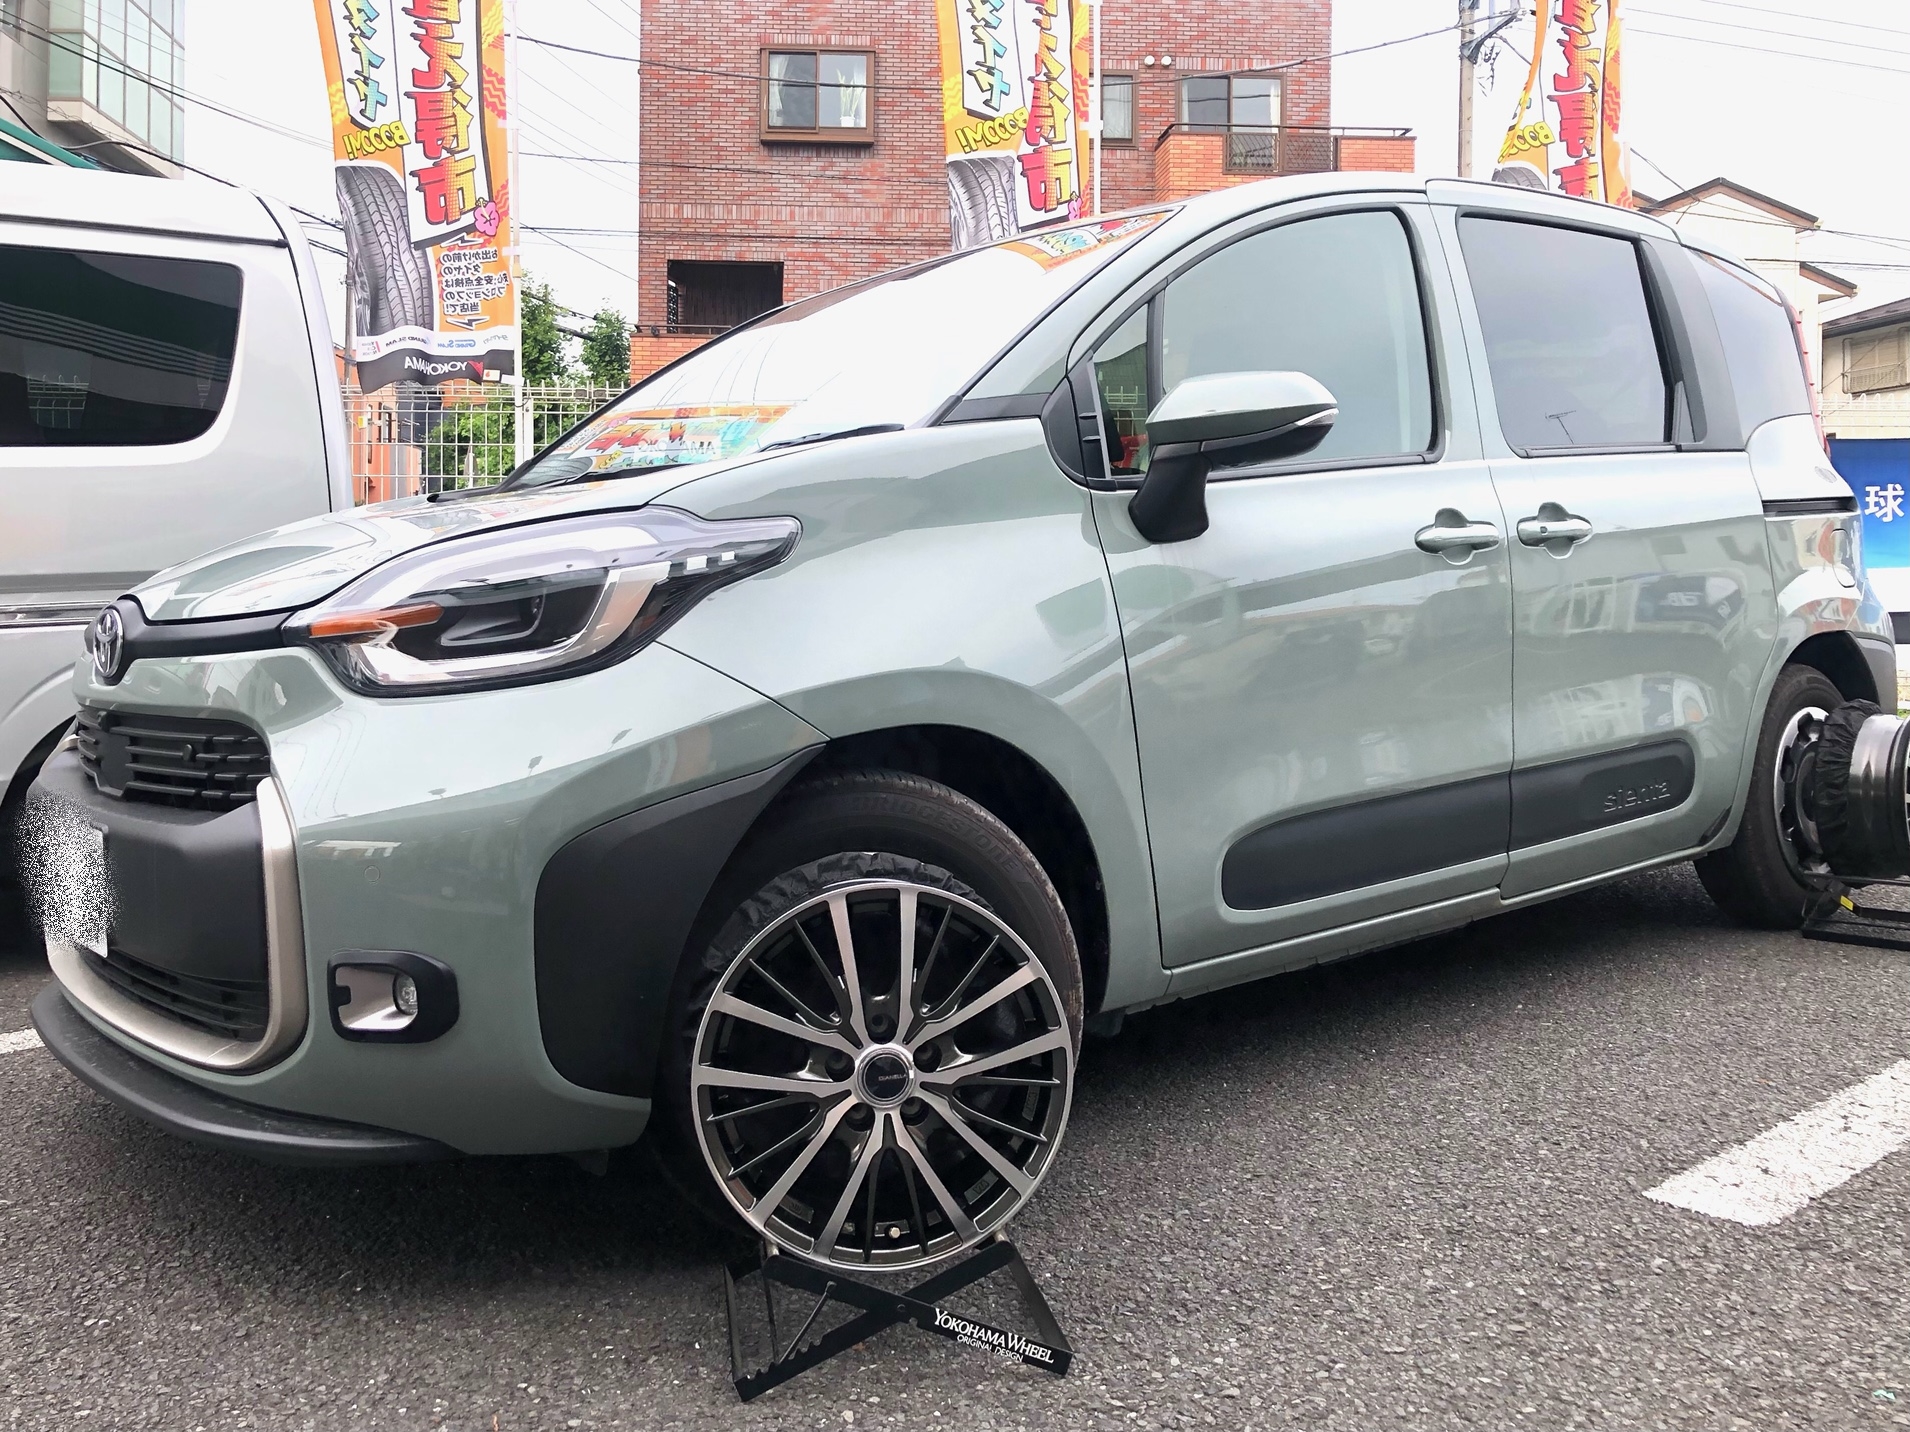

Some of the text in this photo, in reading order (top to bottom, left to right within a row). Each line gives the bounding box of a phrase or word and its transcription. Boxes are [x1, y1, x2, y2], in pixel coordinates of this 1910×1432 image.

[1864, 483, 1905, 523] 球
[933, 1308, 1055, 1364] YOKOHAMA WHEEL
[956, 1334, 1024, 1363] ORIGINAL DESIGN
